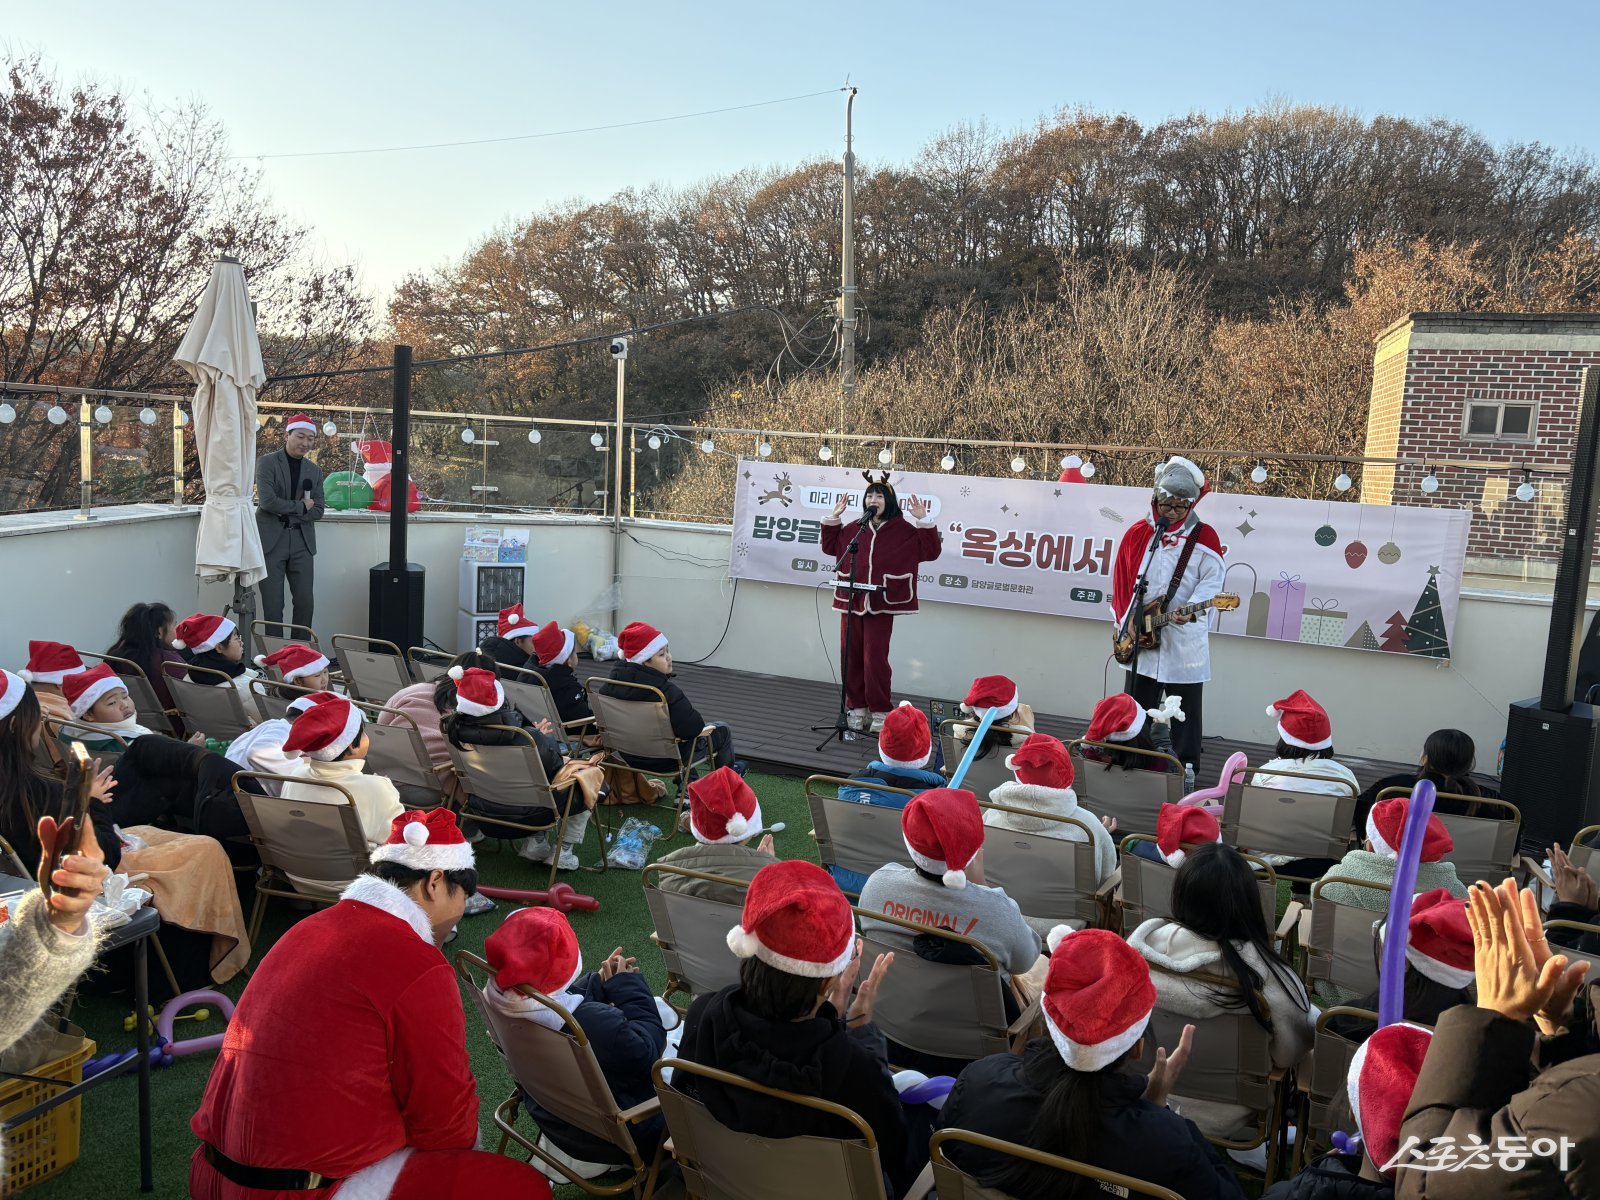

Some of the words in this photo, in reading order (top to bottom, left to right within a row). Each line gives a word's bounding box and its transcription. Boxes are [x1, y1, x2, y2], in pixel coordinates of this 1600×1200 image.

[809, 491, 832, 506] 미리
[752, 515, 822, 544] 담양글
[944, 576, 962, 587] 장소
[1077, 590, 1097, 601] 주관
